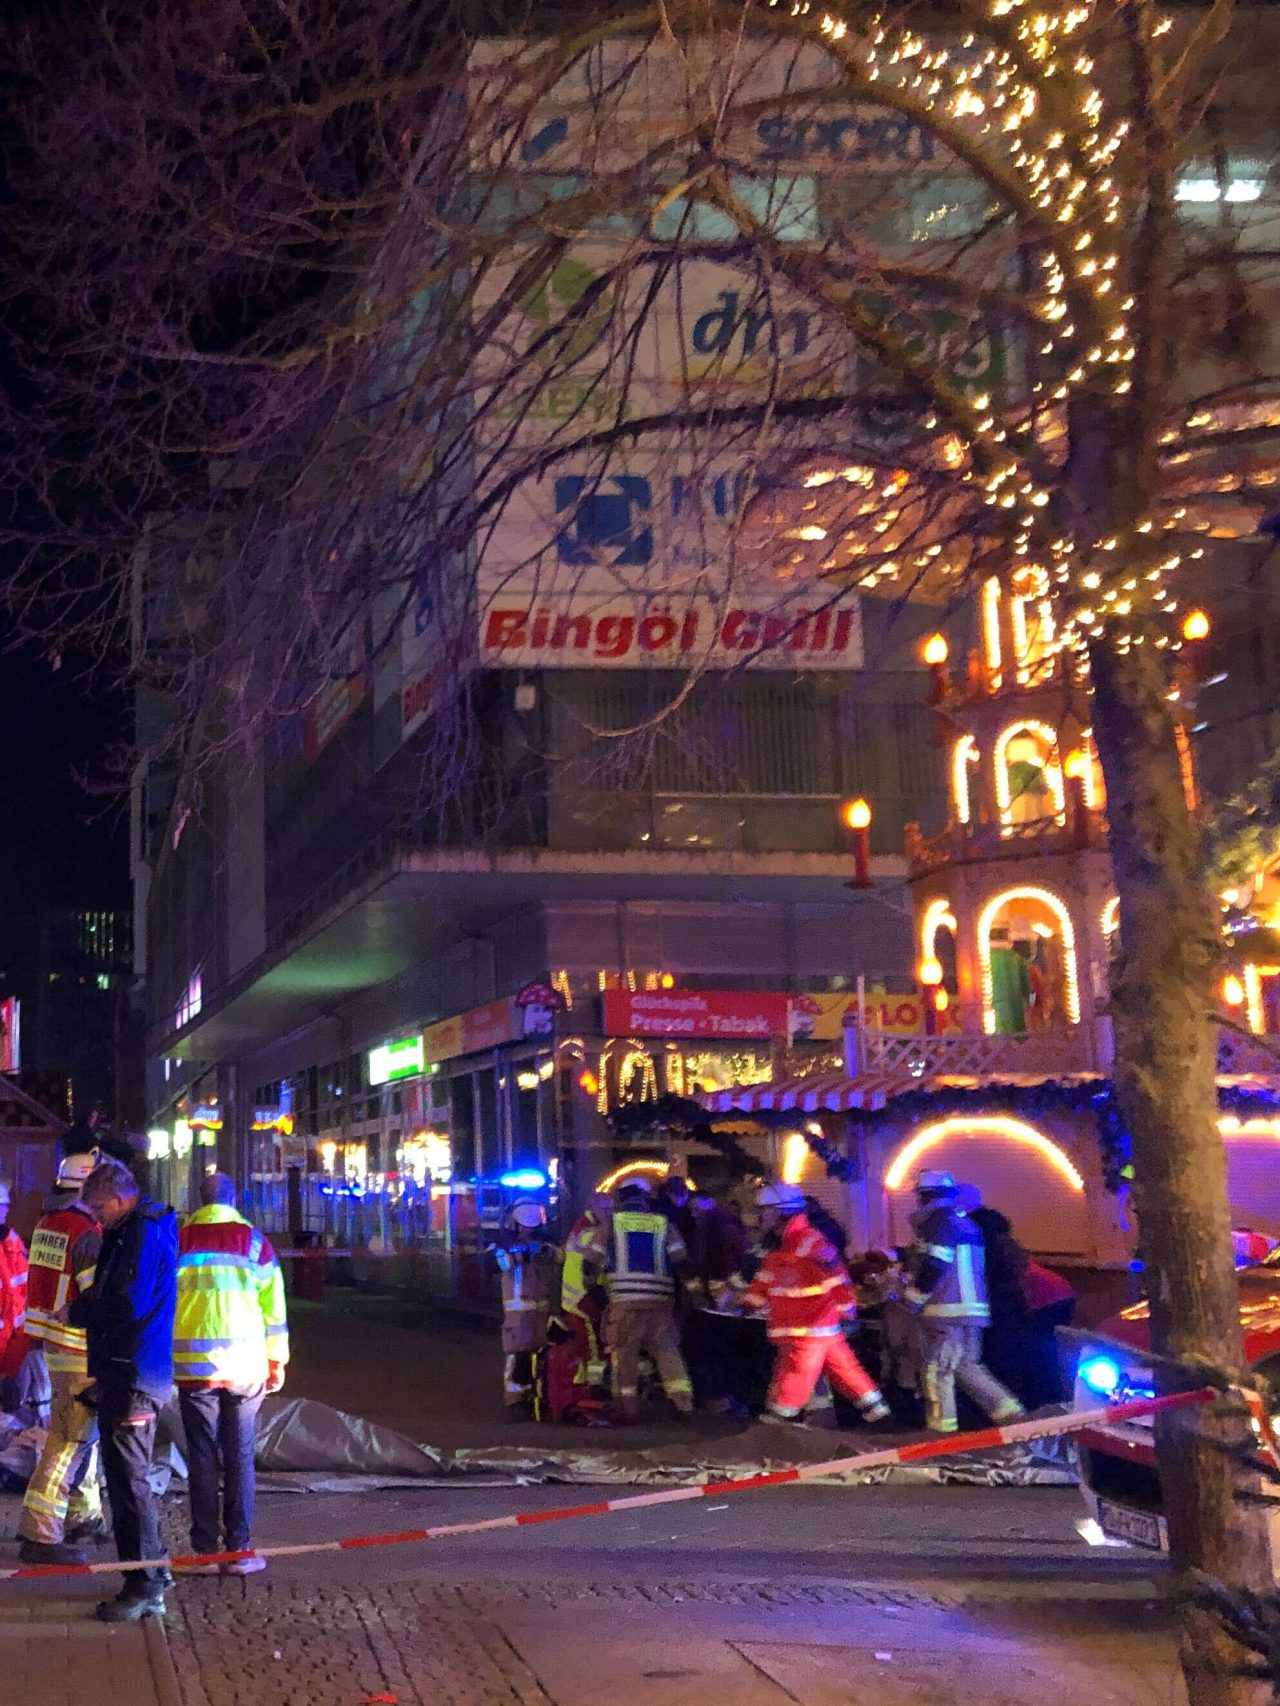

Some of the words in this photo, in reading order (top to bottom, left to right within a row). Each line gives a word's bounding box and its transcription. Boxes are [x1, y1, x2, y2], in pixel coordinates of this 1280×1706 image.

[693, 292, 811, 355] dm
[484, 606, 699, 659] Bingöl
[722, 608, 853, 652] Grill
[630, 1014, 694, 1031] Presse
[708, 1015, 769, 1033] Tabak
